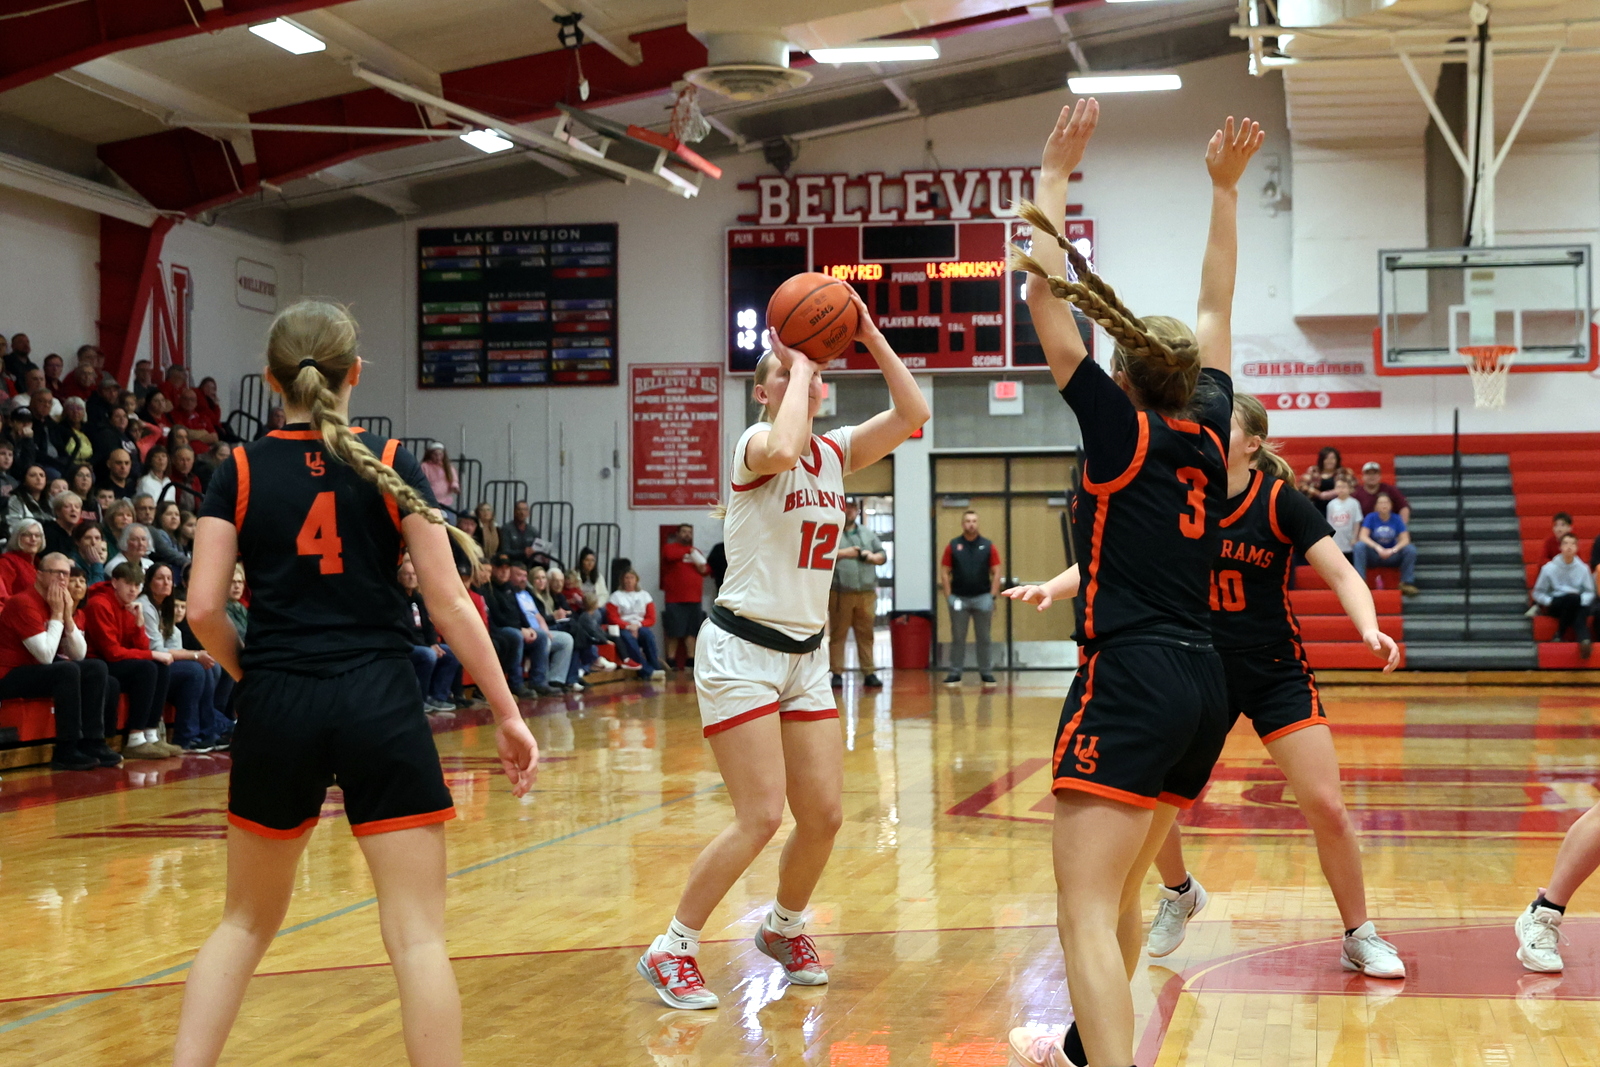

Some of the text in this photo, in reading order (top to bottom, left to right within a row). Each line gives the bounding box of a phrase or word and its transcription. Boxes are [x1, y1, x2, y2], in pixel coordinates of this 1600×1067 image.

[758, 169, 1042, 226] BELLEVU
[453, 229, 581, 243] LAKE DIVISION
[785, 231, 799, 242] PTS
[1017, 224, 1085, 237] PLY PTS
[891, 272, 926, 282] PERIOD
[926, 261, 1005, 279] U.SANDUSKY
[879, 316, 942, 328] PLAYER FOUL
[971, 314, 1003, 326] FOULS
[901, 357, 926, 367] ATCH
[972, 356, 1004, 367] SCORE
[1243, 361, 1365, 377] @BHSRedmen
[635, 376, 717, 394] BELLEVUE HS
[783, 488, 847, 513] BELLEVU
[1176, 466, 1208, 540] 3
[296, 491, 344, 575] 4
[797, 520, 840, 571] 12
[1220, 539, 1274, 568] RAMS
[1208, 569, 1247, 612] 10
